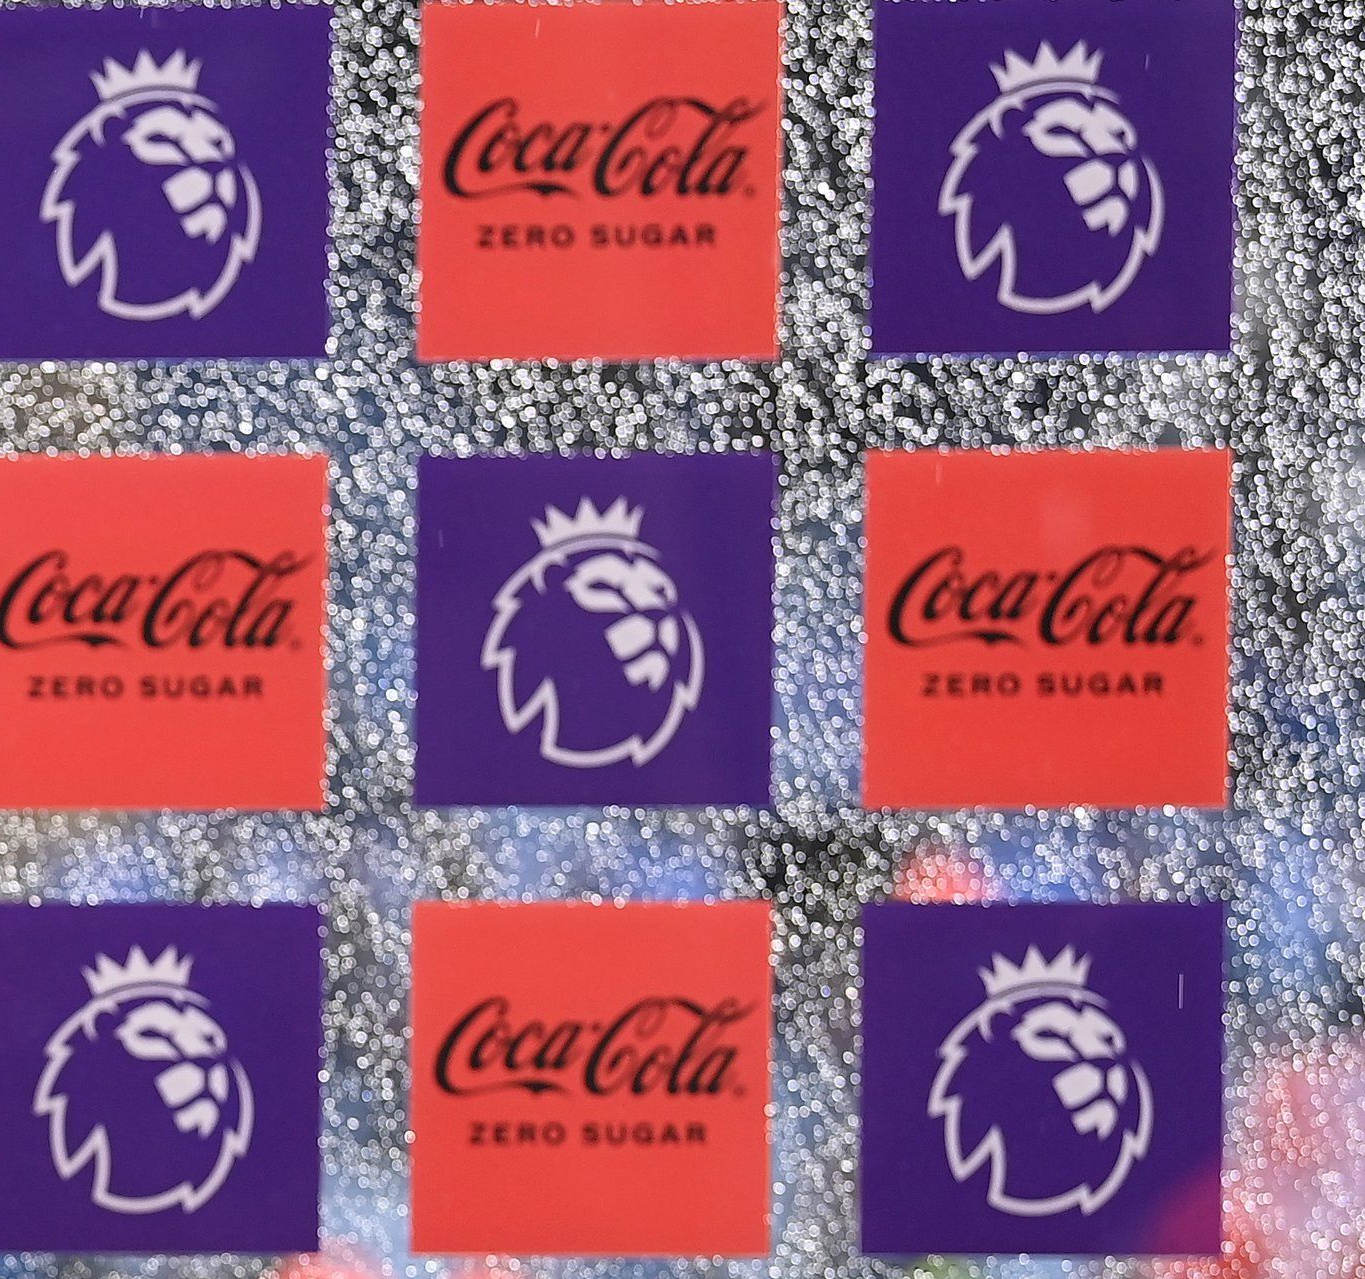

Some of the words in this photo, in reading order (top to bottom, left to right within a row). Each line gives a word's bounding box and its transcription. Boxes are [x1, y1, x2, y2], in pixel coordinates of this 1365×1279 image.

[441, 96, 763, 200] Coca-Cola
[477, 223, 575, 249] ZERO
[590, 223, 716, 249] SUGAR
[885, 545, 1213, 648] Coca-Cola
[28, 675, 124, 699] ZERO
[139, 675, 263, 699] SUGAR
[922, 672, 1022, 697] ZERO
[1037, 672, 1164, 697] SUGAR
[432, 997, 753, 1097] Coca-Cola
[469, 1122, 566, 1146] ZERO
[582, 1122, 706, 1146] SUGAR
